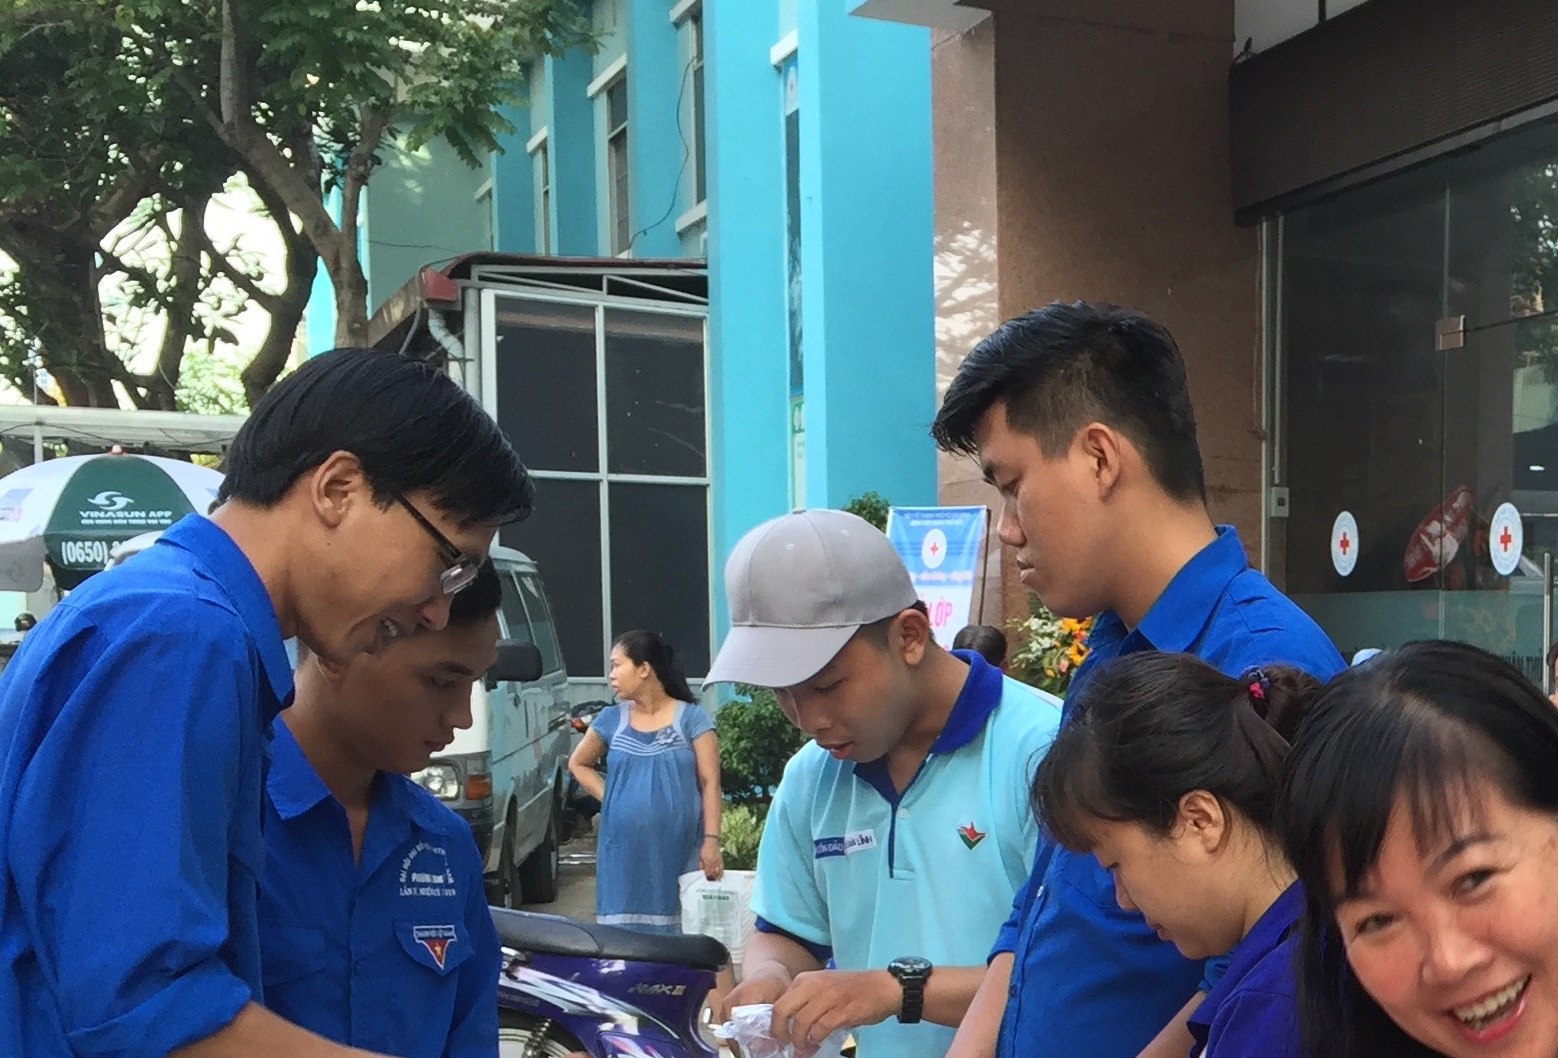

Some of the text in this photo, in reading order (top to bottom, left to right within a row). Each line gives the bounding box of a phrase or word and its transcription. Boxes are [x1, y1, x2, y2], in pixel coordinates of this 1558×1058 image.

[79, 510, 173, 518] VINASUN APP
[61, 540, 109, 565] (0650)
